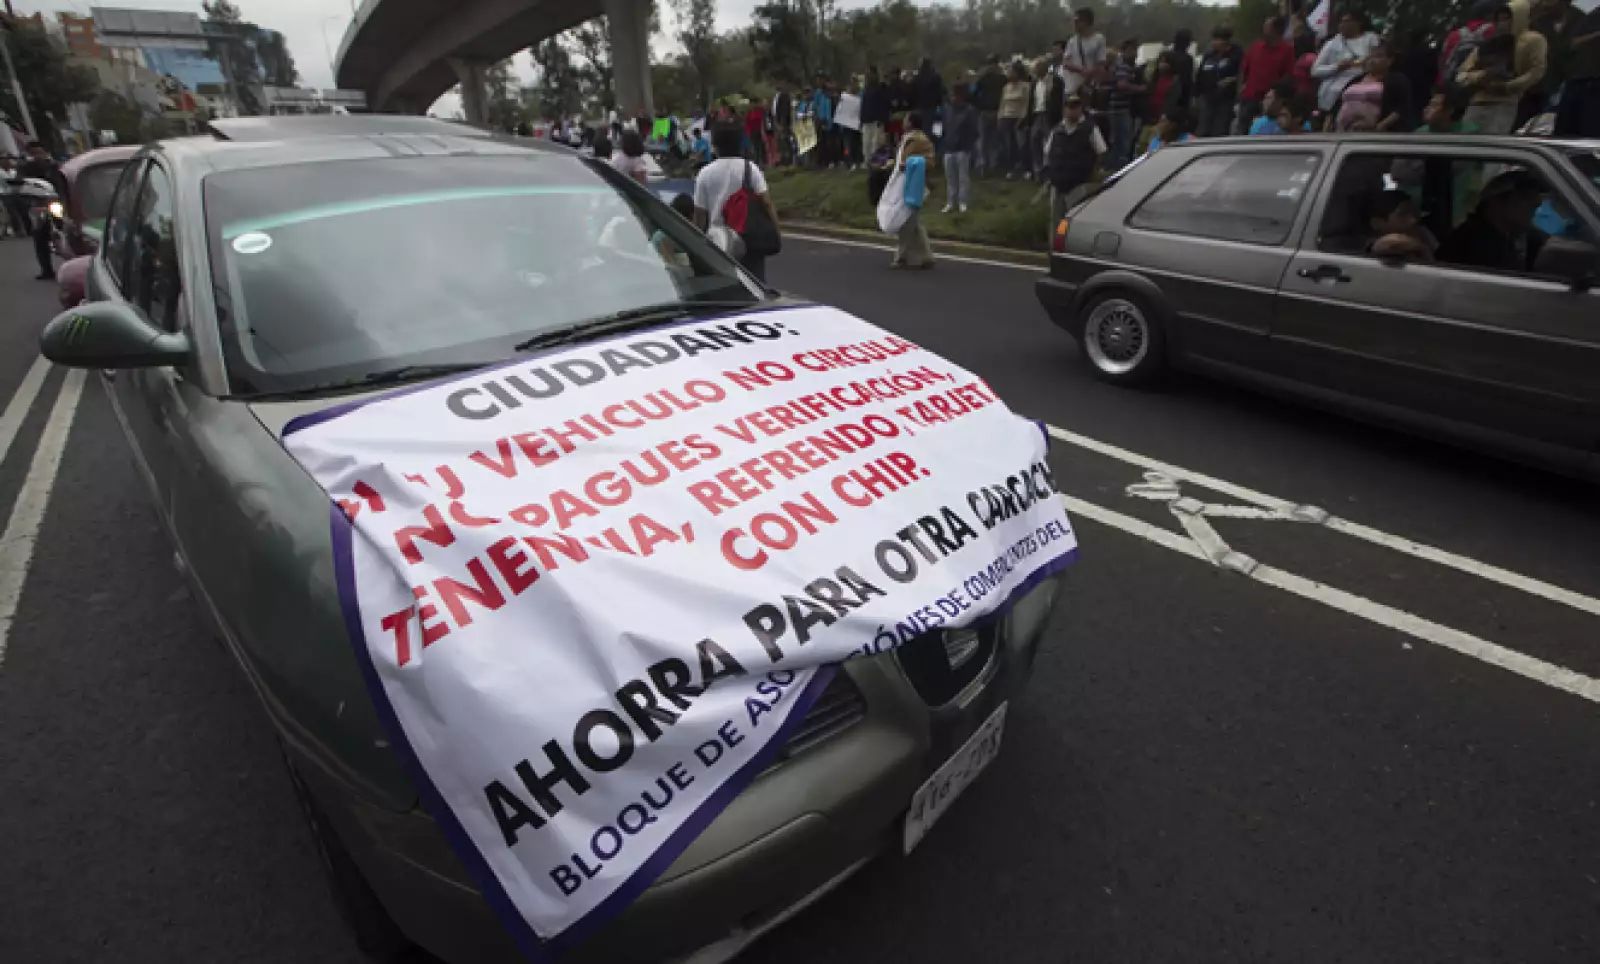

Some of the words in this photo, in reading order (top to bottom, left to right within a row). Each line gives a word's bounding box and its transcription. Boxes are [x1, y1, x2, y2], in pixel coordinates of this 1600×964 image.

[446, 320, 800, 420] CIUDADANO:
[467, 379, 727, 479] VEHICULO
[721, 360, 796, 392] NO
[507, 434, 723, 529] PAGUES
[713, 365, 957, 445] VERIFICACIÓN,
[380, 512, 696, 669] TENENIA,
[686, 413, 916, 517] REFRENDO,
[719, 491, 839, 571] CON
[830, 451, 932, 507] CHIP.
[483, 637, 749, 849] AHORRA
[742, 565, 888, 664] PARA
[874, 506, 979, 583] OTRA
[549, 761, 696, 897] BLOQUE
[693, 720, 746, 768] DE
[935, 586, 972, 618] DE
[1035, 518, 1071, 547] DEL
